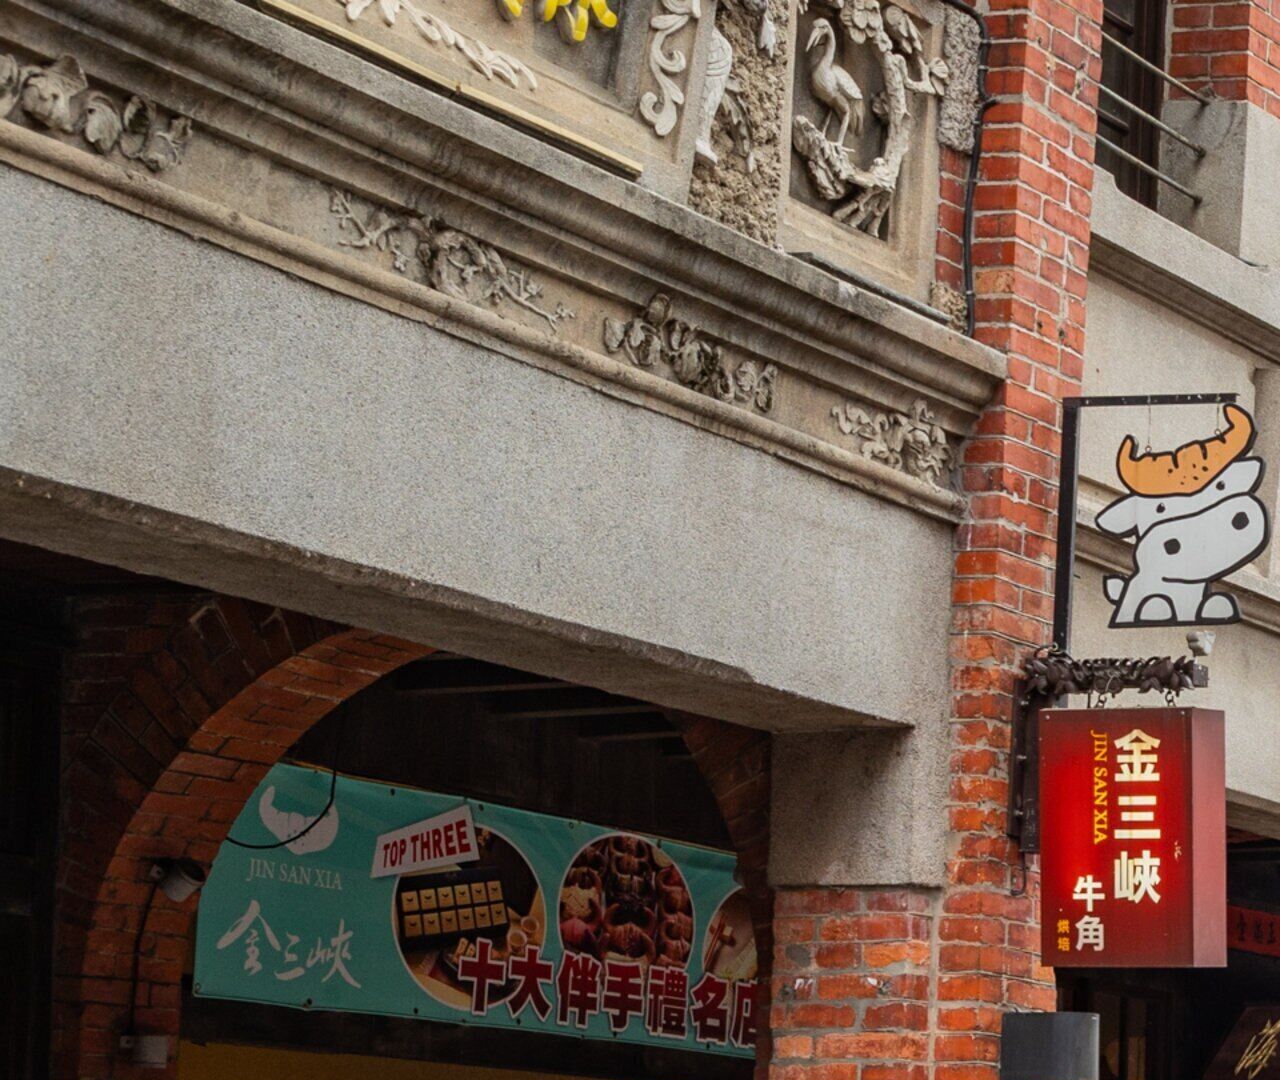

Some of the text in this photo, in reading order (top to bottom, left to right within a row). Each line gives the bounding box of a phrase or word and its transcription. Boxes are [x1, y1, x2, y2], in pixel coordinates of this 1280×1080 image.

[1090, 730, 1108, 845] JIN SAN XIA
[1113, 728, 1161, 904] 金三峽
[246, 857, 343, 890] JIN SAN XIA
[382, 818, 472, 869] TOP THREE
[216, 899, 362, 989] 金三峽
[1072, 874, 1106, 952] 牛角
